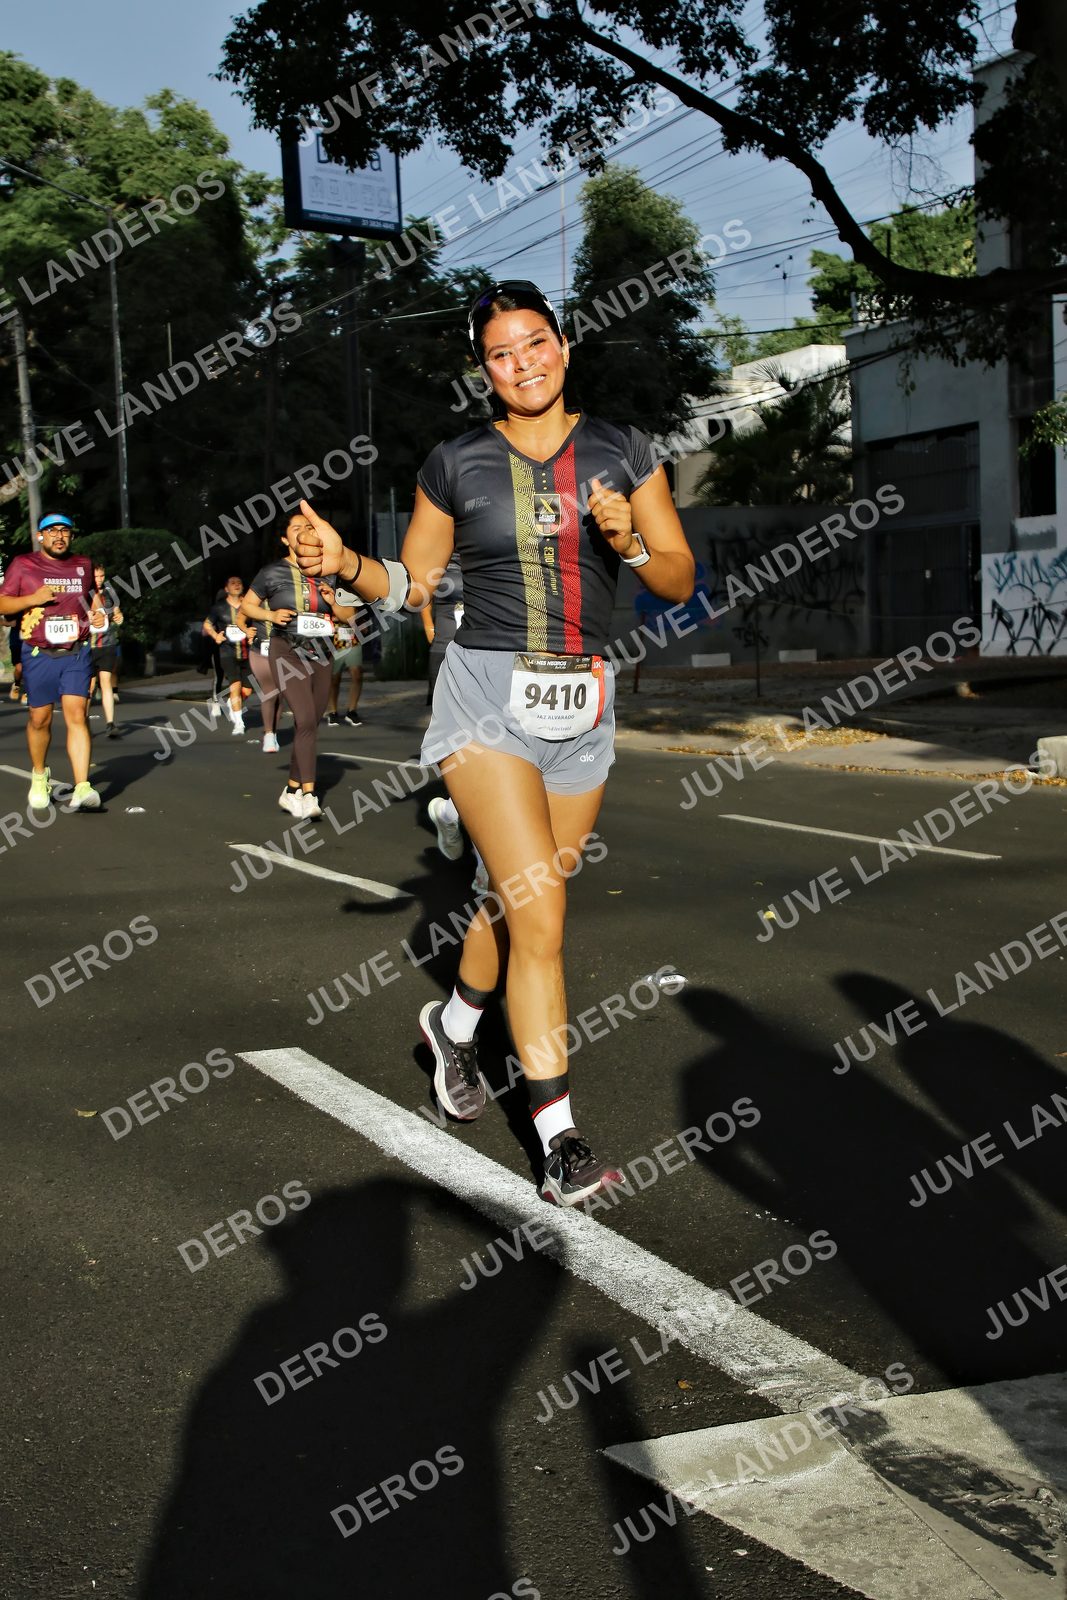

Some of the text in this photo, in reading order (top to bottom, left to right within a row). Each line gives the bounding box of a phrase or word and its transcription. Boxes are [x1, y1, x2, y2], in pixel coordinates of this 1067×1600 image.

[48, 624, 74, 633] 10611
[525, 683, 587, 711] 9410
[579, 751, 595, 762] alo
